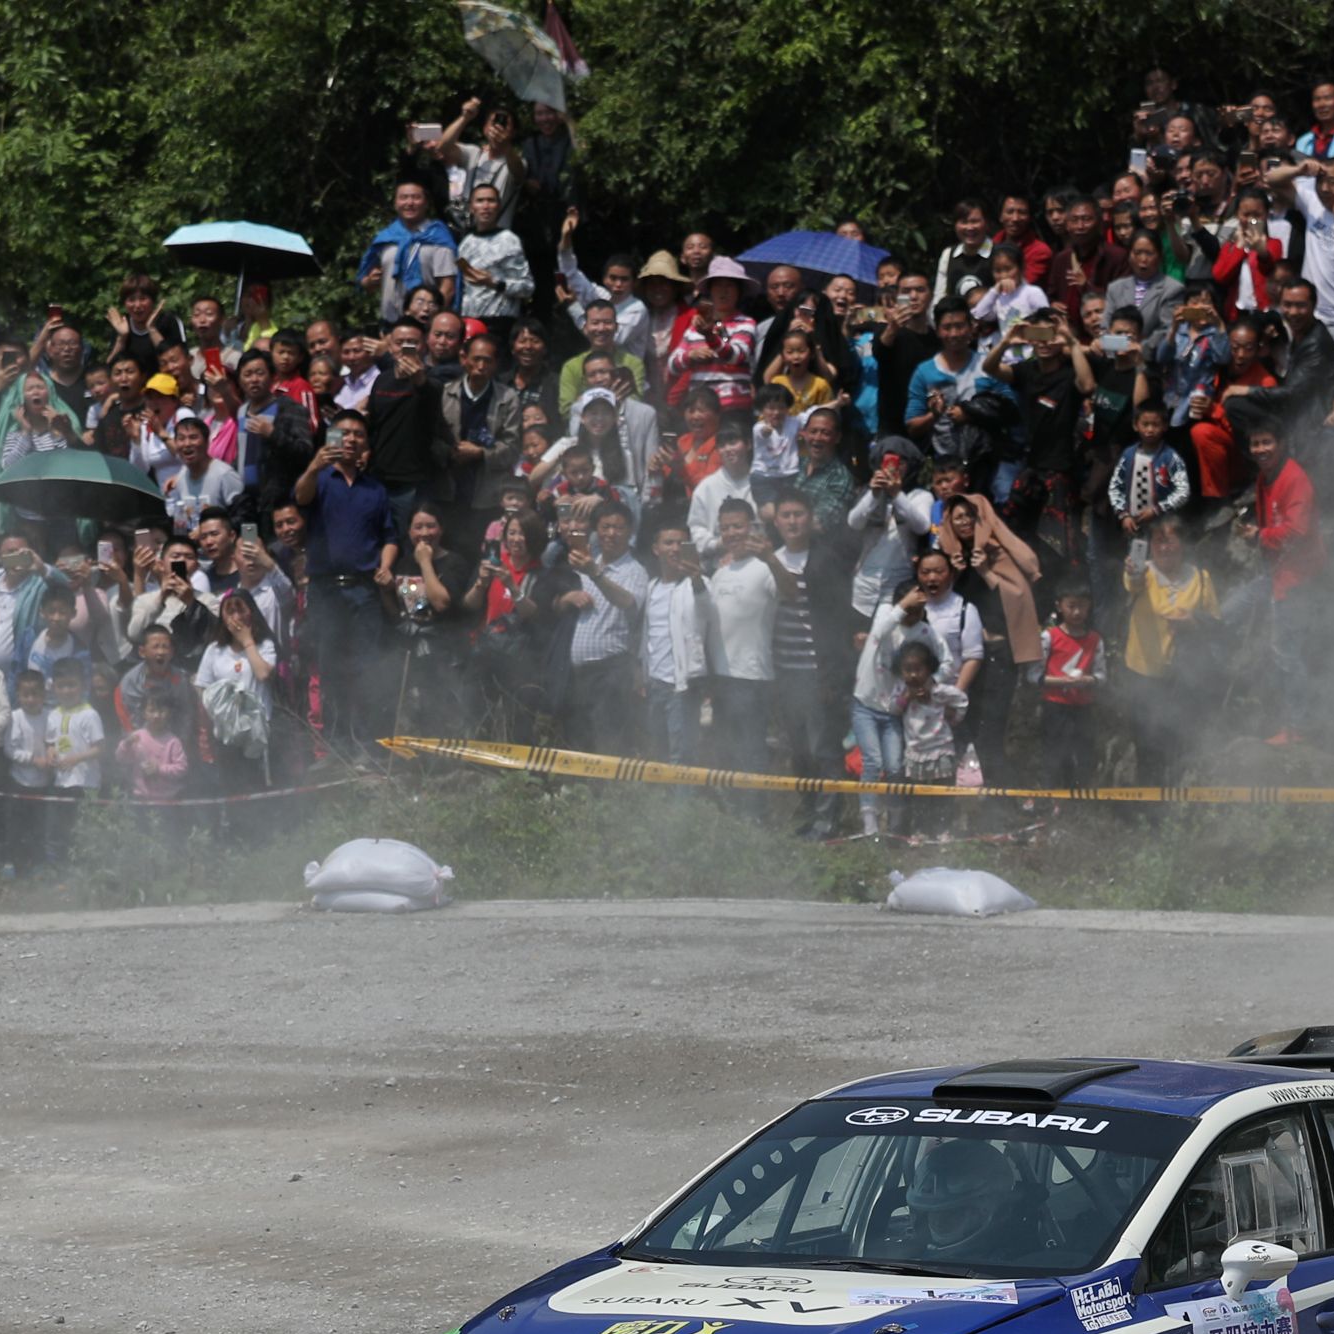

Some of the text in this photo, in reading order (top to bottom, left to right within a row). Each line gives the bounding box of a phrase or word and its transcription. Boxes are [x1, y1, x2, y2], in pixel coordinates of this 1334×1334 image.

[913, 1108, 1110, 1135] SUBARU
[678, 1282, 817, 1294] SUBARU
[582, 1297, 710, 1306] SUBARU
[717, 1296, 844, 1314] XV
[1077, 1292, 1131, 1317] Motorsport
